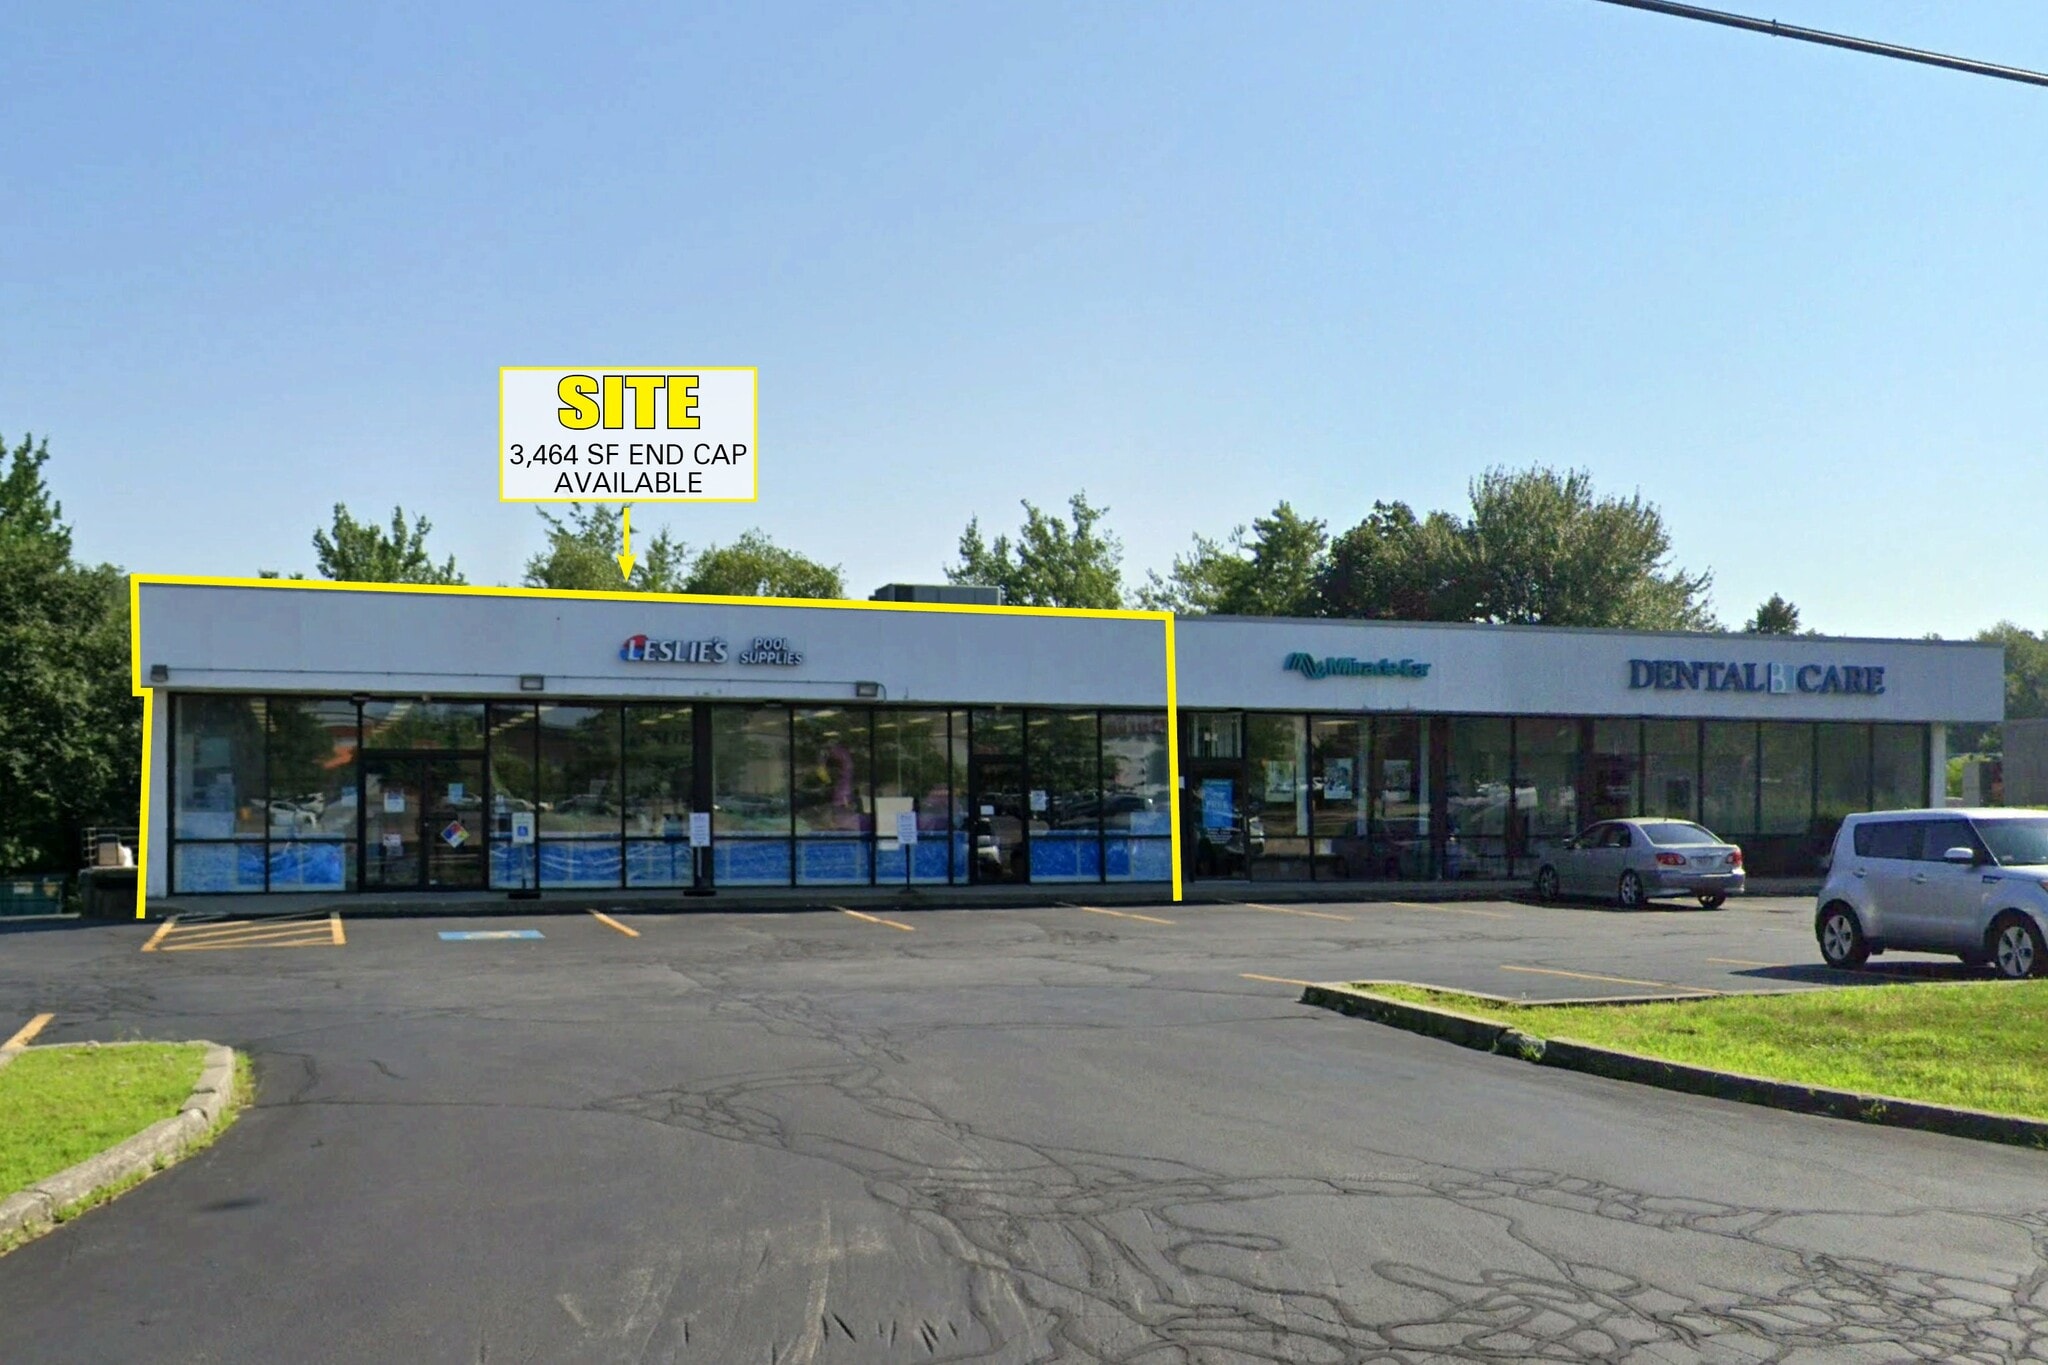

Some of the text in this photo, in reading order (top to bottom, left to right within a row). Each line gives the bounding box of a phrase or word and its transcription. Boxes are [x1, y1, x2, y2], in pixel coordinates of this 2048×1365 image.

[627, 637, 729, 663] LESLIE'S
[753, 637, 789, 650] POOL
[739, 651, 803, 665] SUPPLIES
[1628, 659, 1766, 693] DENTAL
[1797, 664, 1886, 695] CARE
